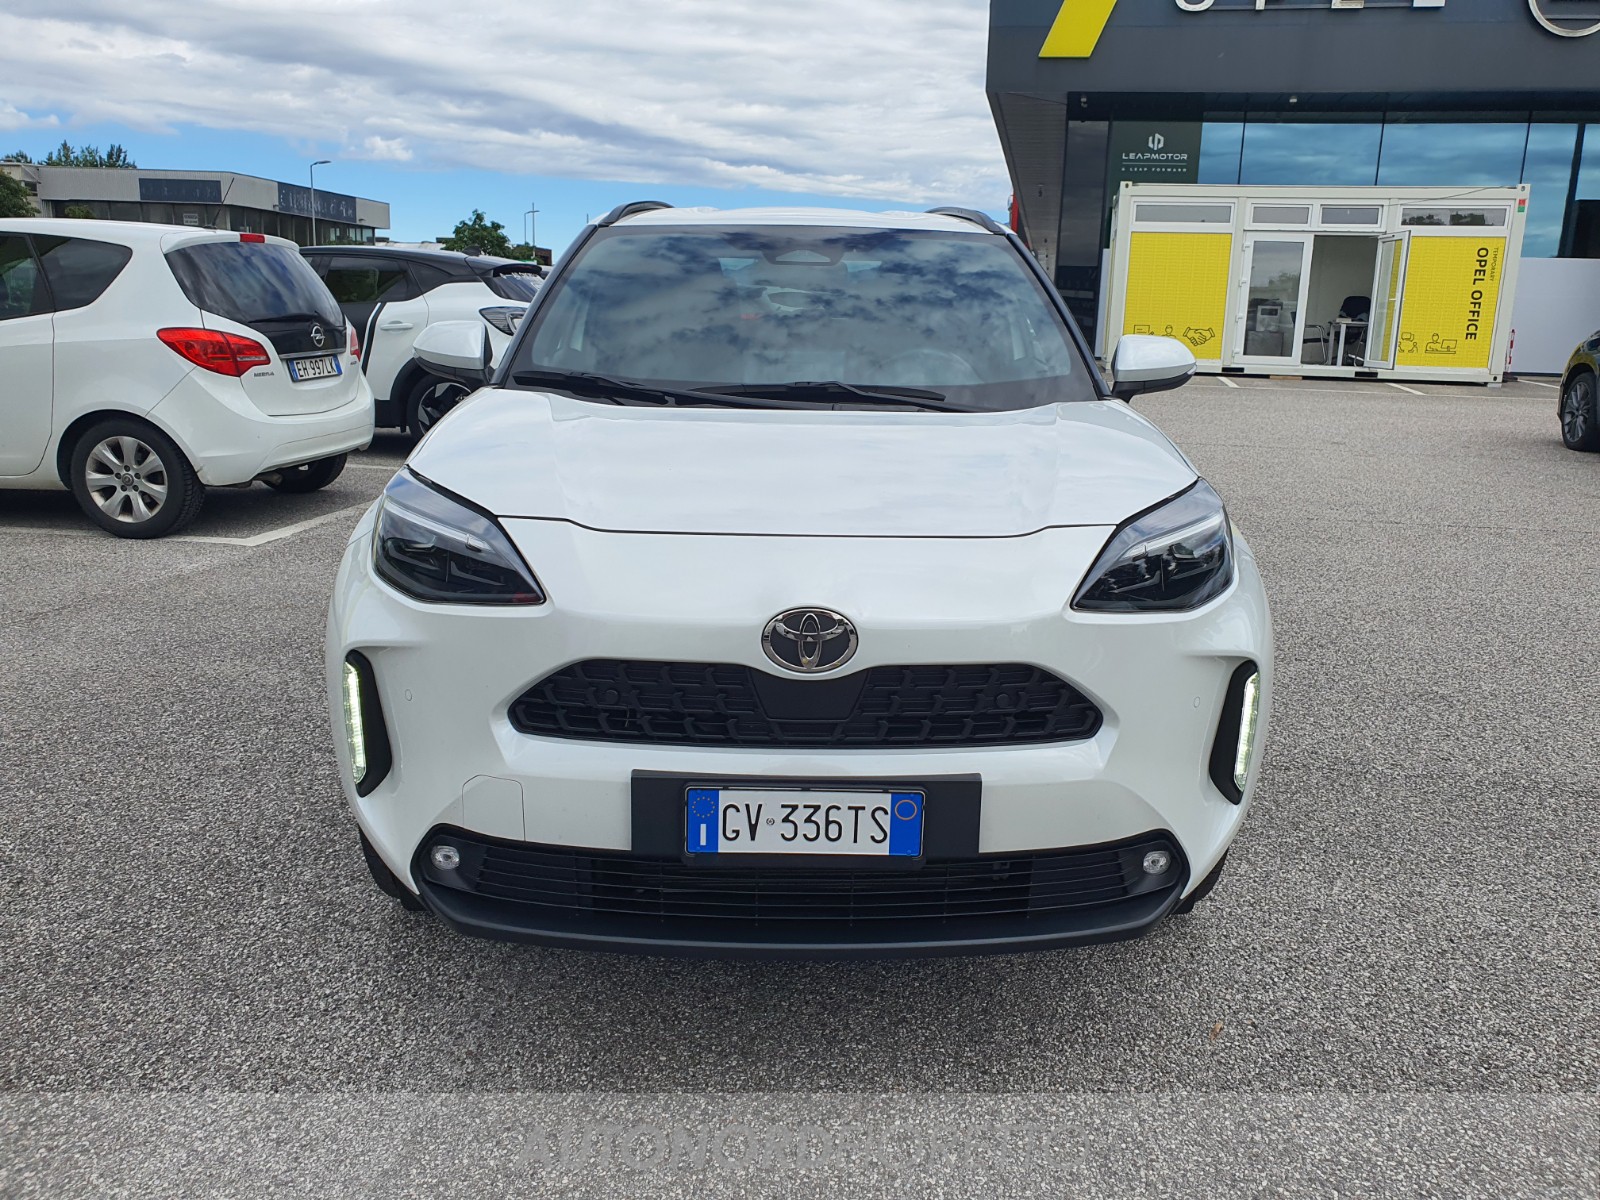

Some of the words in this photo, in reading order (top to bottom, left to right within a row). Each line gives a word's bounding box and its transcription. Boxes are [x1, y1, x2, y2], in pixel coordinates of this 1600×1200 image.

[1473, 248, 1489, 285] OPEL
[1489, 247, 1499, 282] TEMPORARY
[1465, 290, 1483, 340] OFFICE
[295, 360, 310, 378] EH
[309, 357, 337, 377] 997LK
[721, 802, 763, 842] GV
[780, 803, 889, 844] 336TS
